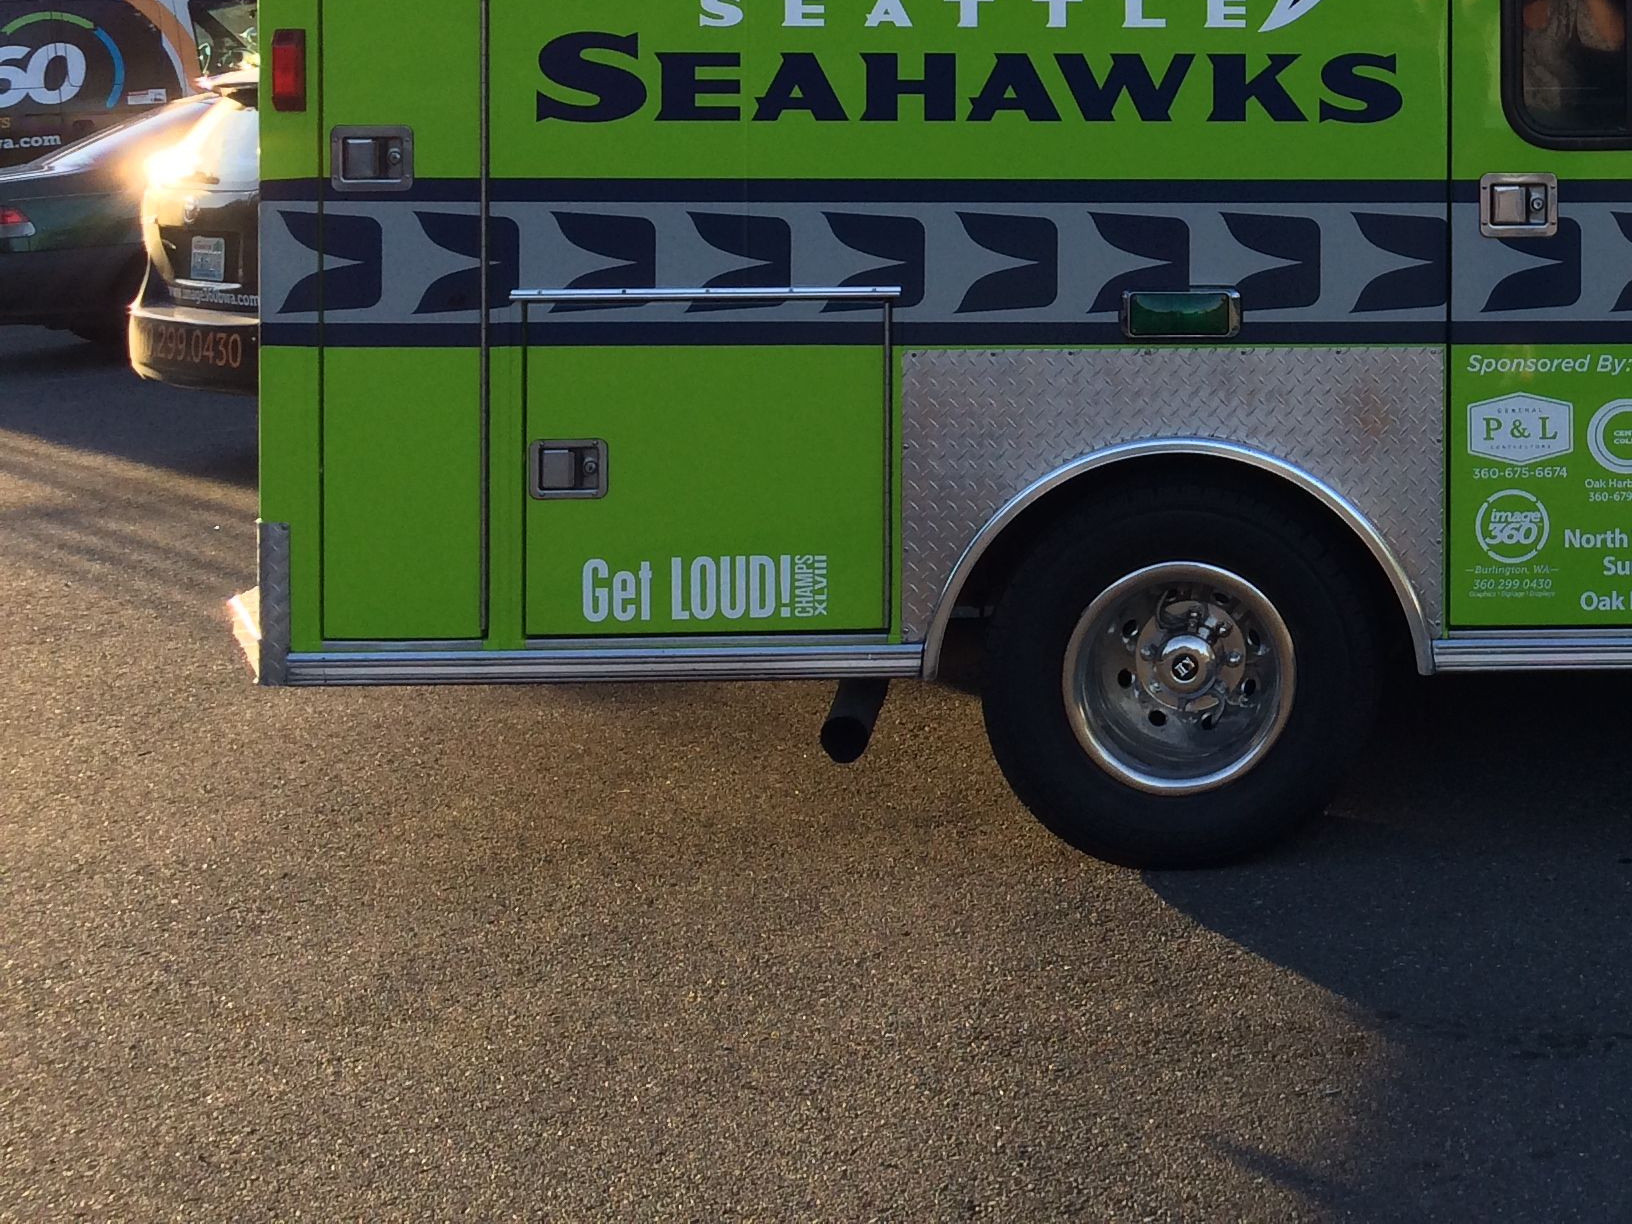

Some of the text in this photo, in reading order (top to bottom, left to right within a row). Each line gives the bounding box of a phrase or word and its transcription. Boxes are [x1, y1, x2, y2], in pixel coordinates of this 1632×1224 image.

[535, 30, 1404, 124] SEAHAWKS
[1467, 354, 1632, 376] Sponsored By:
[1482, 417, 1559, 441] P & L
[1472, 466, 1568, 479] 360-675-6674
[1585, 478, 1606, 488] Oak
[1491, 509, 1541, 524] image
[1485, 522, 1538, 544] 360
[1564, 528, 1628, 548] North
[583, 554, 791, 622] Get LOUD!
[795, 554, 814, 617] CHAMPS
[814, 555, 828, 615] XLVIII
[1473, 579, 1552, 589] 360 299 0430
[1580, 591, 1625, 611] Oak
